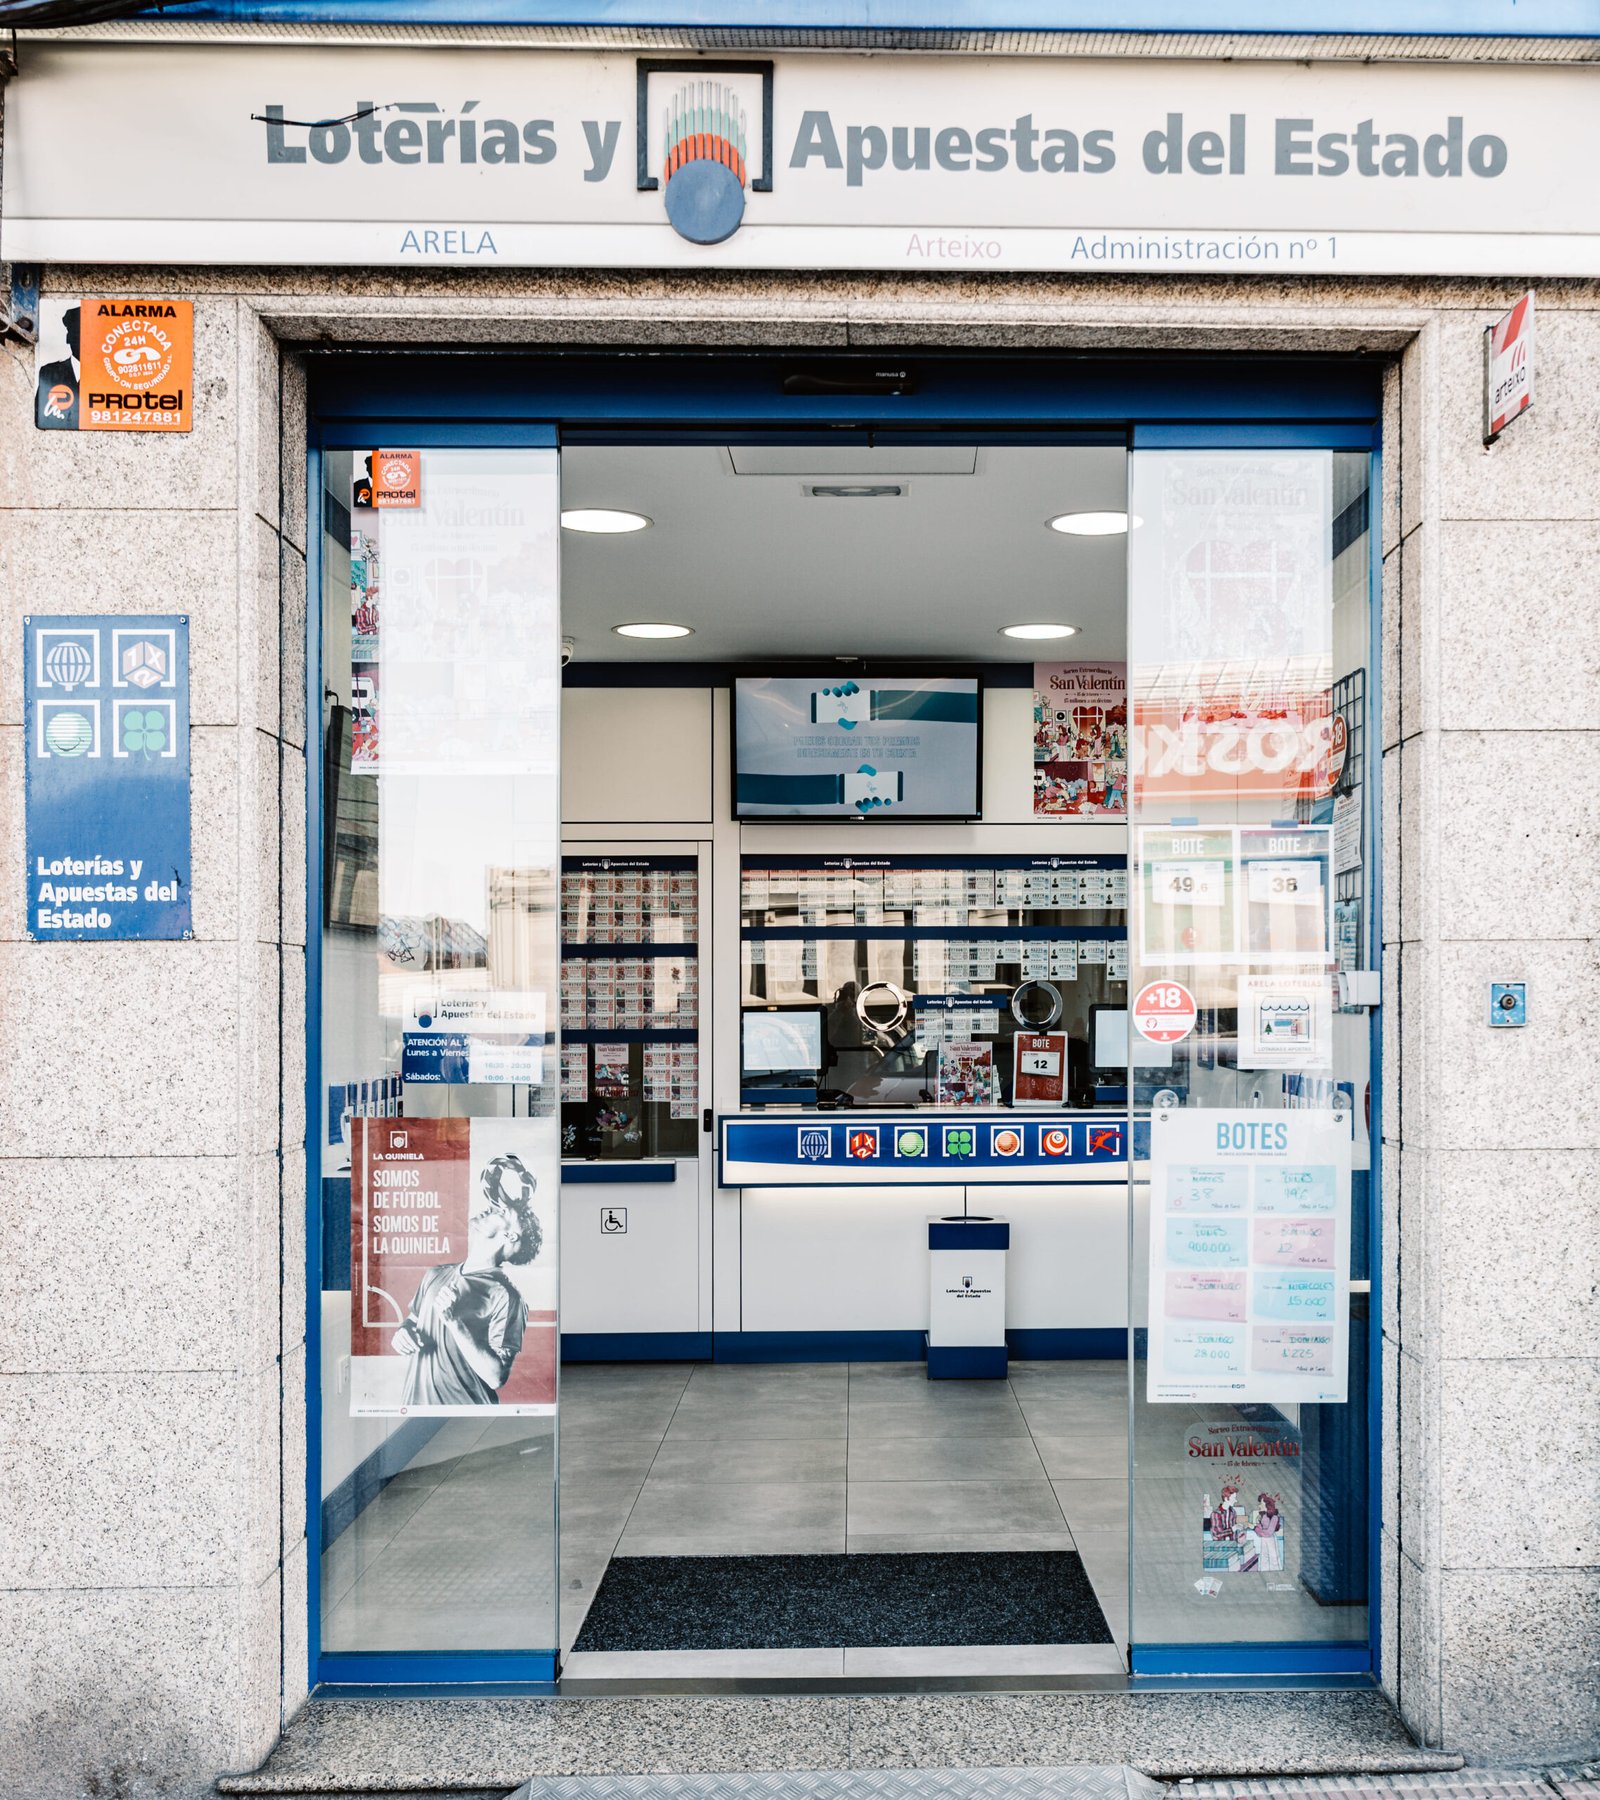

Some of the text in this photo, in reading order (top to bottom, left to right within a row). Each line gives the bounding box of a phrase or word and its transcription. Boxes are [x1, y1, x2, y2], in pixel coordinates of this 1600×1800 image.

[264, 101, 1508, 187] Loterías y Apuestas del Estado
[400, 230, 498, 254] ARELA
[905, 233, 1003, 259] Arteixo
[1071, 233, 1281, 260] Administración
[1328, 236, 1338, 259] 1
[97, 304, 177, 318] ALARMA
[101, 320, 173, 354] CONECTADA
[124, 335, 147, 347] 24H
[103, 357, 120, 383] GRUPO
[120, 379, 132, 389] ON
[133, 363, 171, 391] SEGURIDAD
[117, 361, 162, 375] 902811611
[1494, 366, 1527, 405] arteixo
[90, 410, 181, 422] 981247881
[1050, 674, 1126, 690] San Valentín
[1171, 837, 1205, 855] BOTE
[1268, 836, 1302, 854] BOTE
[38, 855, 143, 881] Loterías y
[38, 880, 178, 908] Apuestas del
[37, 908, 112, 929] Estado
[1247, 980, 1275, 988] ARELA
[1145, 987, 1182, 1009] +18
[440, 1008, 485, 1020] Apuestas
[407, 1037, 448, 1047] ATENCIÓN
[450, 1038, 462, 1047] AL
[1032, 1039, 1050, 1048] BOTE
[406, 1048, 430, 1057] Lunes
[1033, 1059, 1048, 1069] 12
[405, 1072, 442, 1082] Sábados:
[1216, 1122, 1289, 1150] BOTES
[385, 1153, 425, 1161] QUINIELA
[373, 1169, 420, 1188] SOMOS
[373, 1187, 442, 1209] DE FÚTBOL
[373, 1215, 440, 1233] SOMOS DE
[373, 1236, 451, 1255] LA QUINIELA
[1208, 1425, 1231, 1436] Sorteo
[1188, 1434, 1300, 1458] San Valentín
